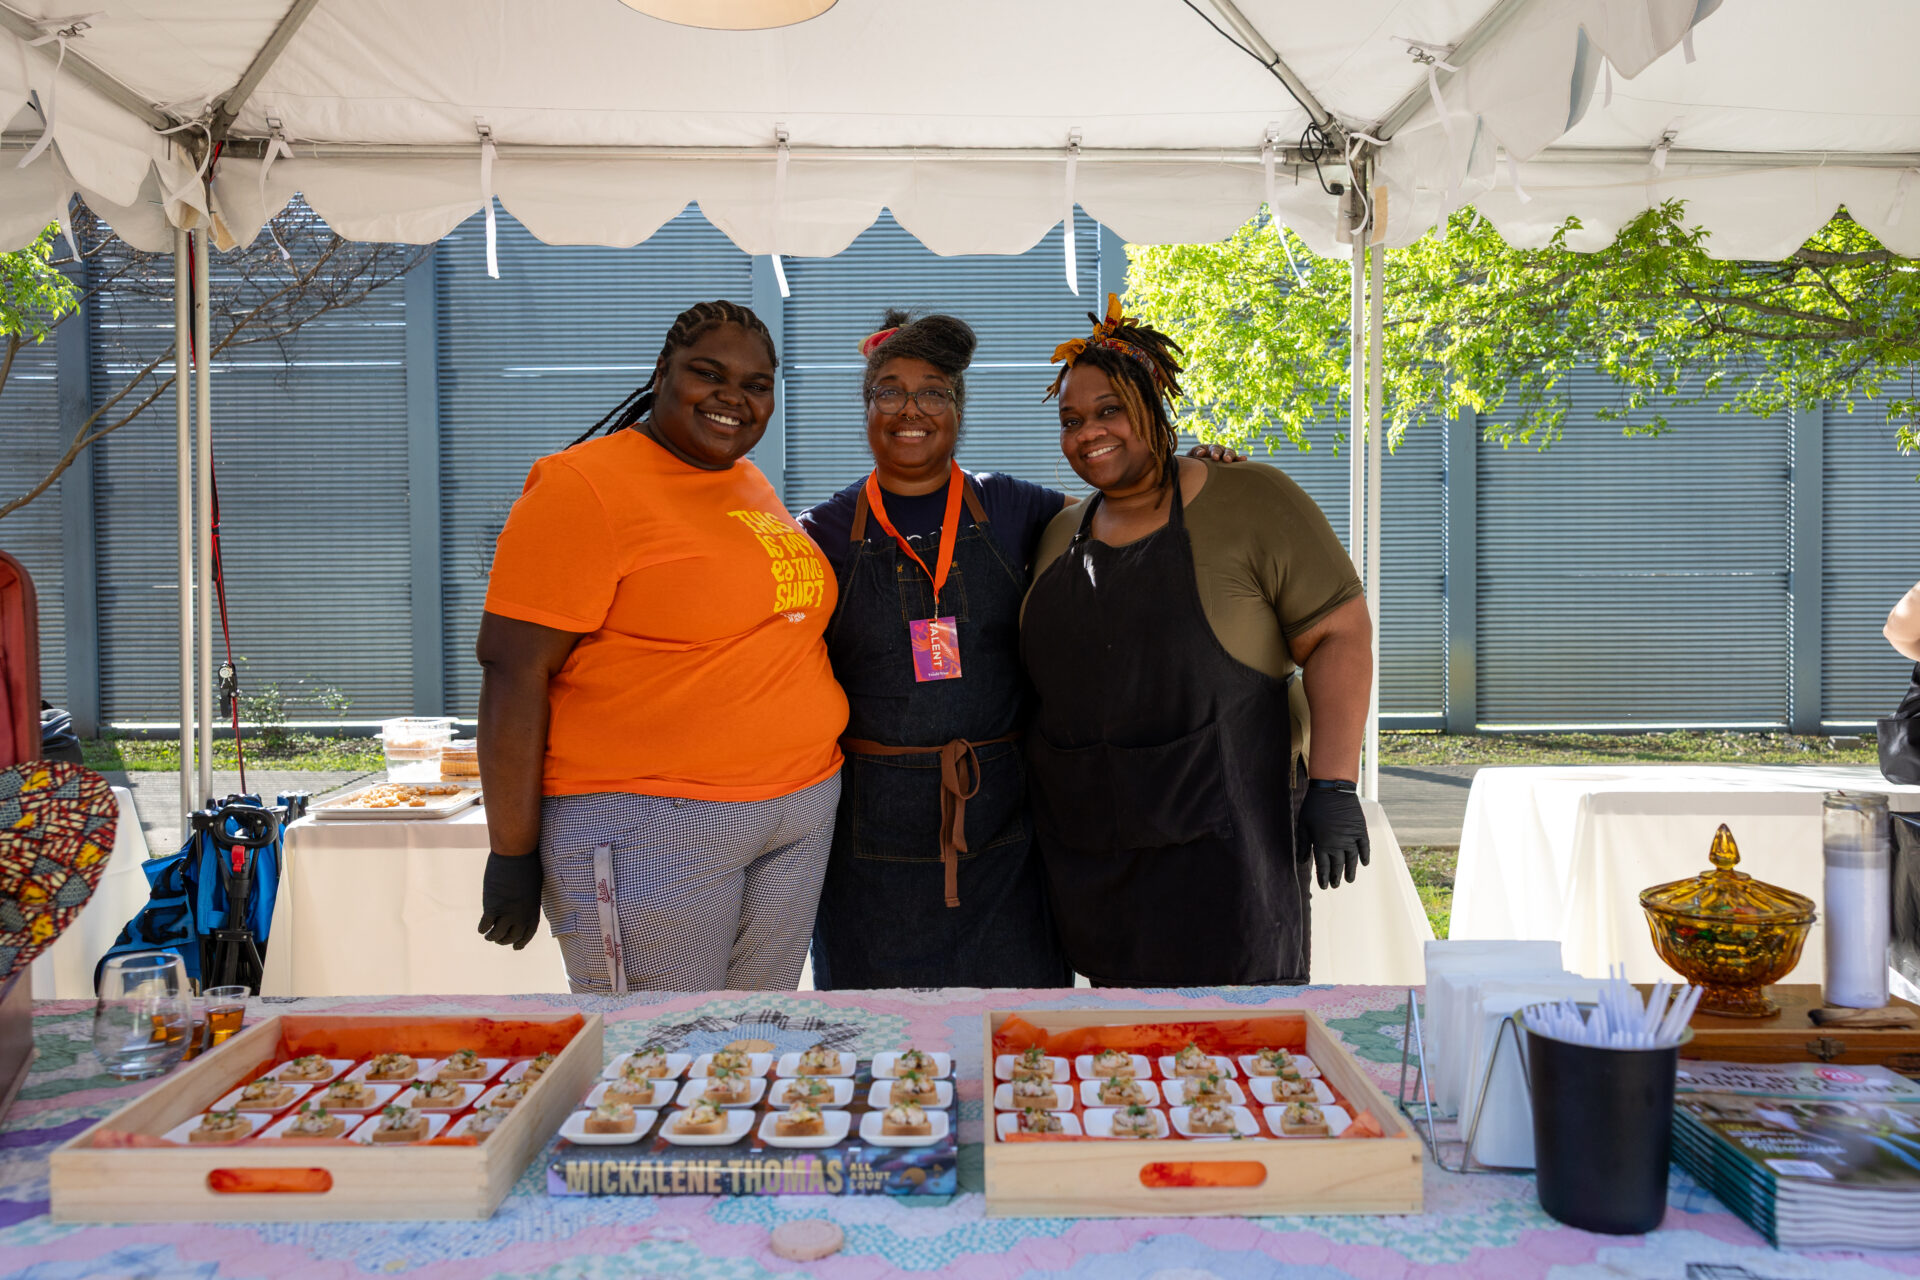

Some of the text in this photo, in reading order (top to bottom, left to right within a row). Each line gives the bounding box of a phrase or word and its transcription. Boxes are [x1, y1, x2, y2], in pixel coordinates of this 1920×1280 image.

[726, 510, 795, 534] THIS
[755, 533, 814, 558] IS MY
[773, 580, 824, 613] SHIRT
[929, 622, 942, 667] TALENT
[566, 1159, 844, 1193] MICKALENE THOMAS
[849, 1162, 872, 1172] ALL
[849, 1171, 891, 1181] ABOUT
[849, 1180, 881, 1190] LOVE
